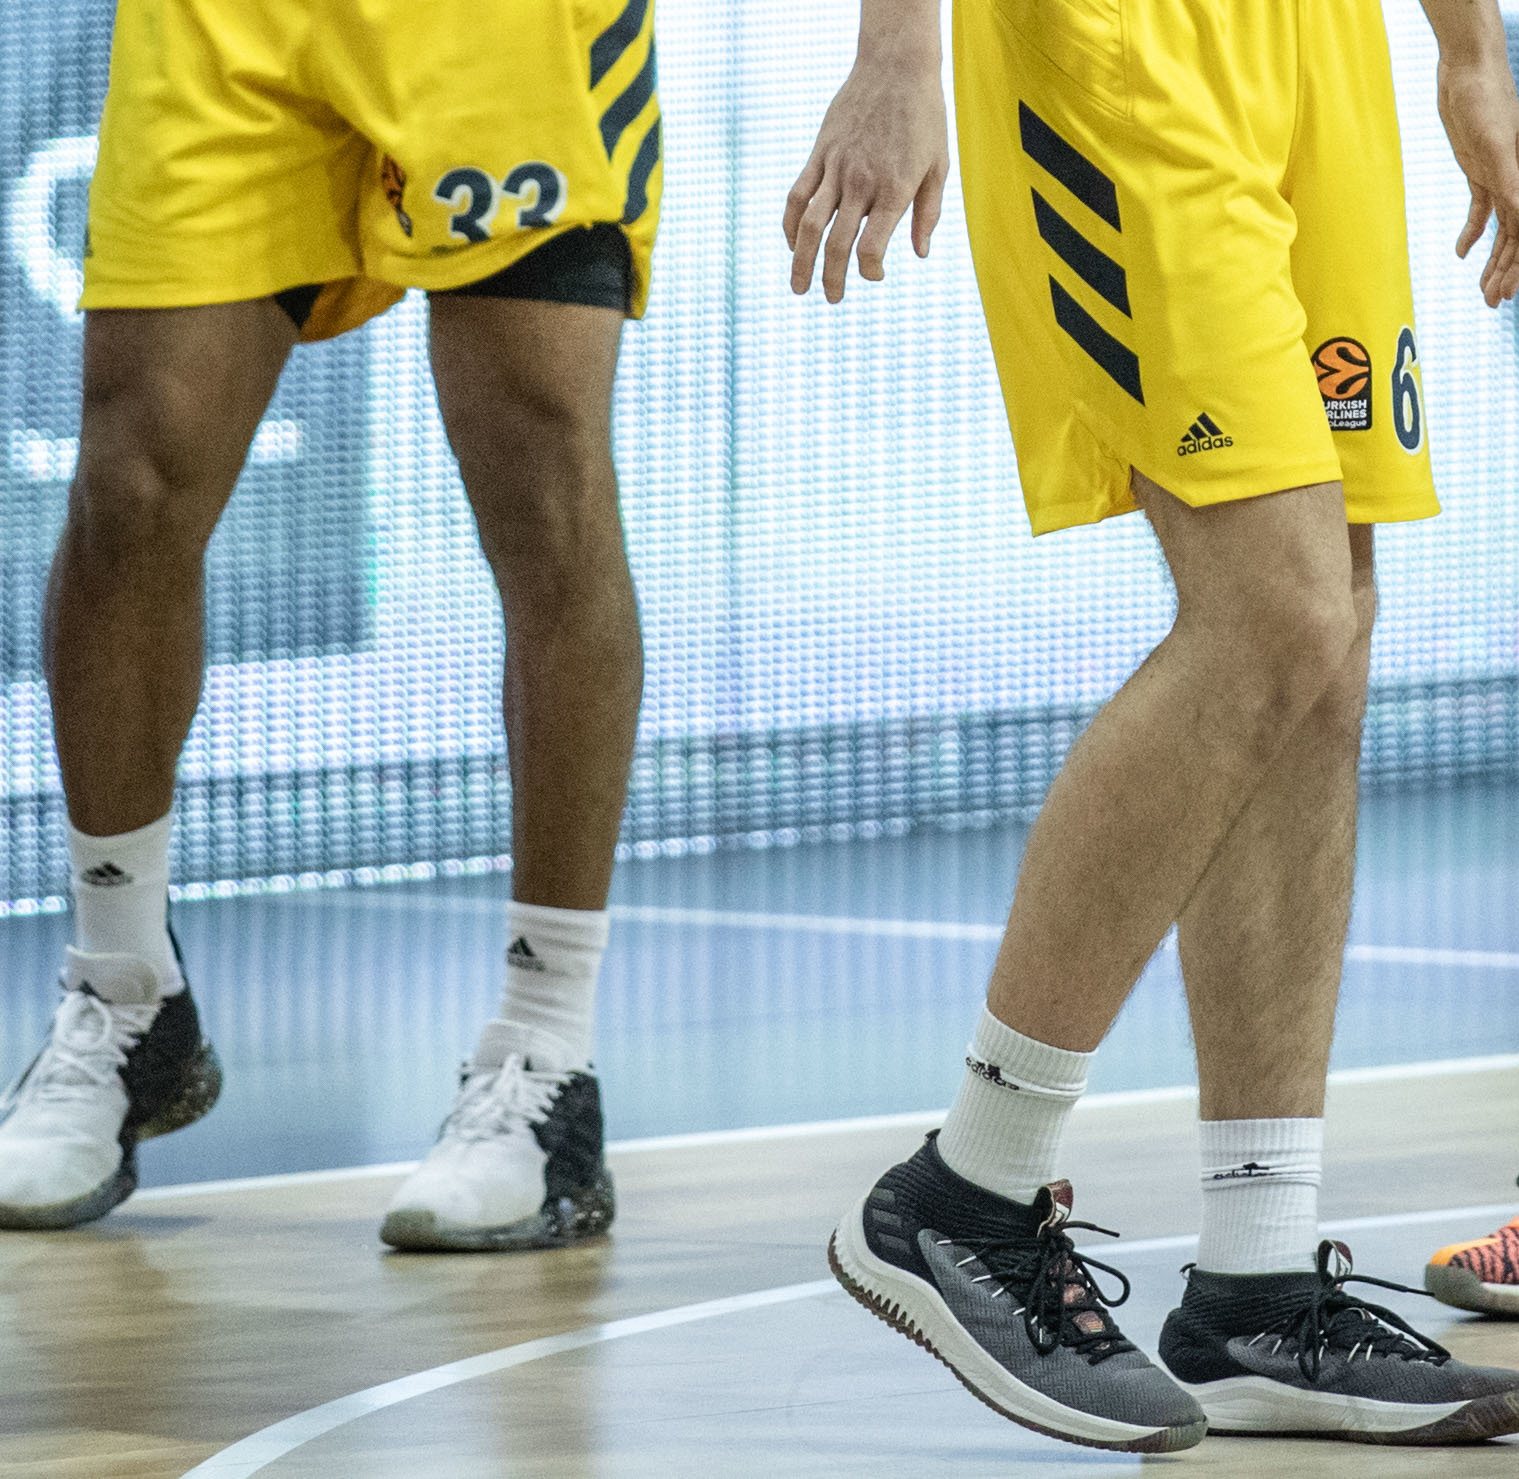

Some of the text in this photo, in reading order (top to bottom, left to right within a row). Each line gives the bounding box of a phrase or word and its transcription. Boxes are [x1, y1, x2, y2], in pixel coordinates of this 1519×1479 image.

[1391, 324, 1425, 456] 6
[1325, 399, 1368, 410] URKISH
[1327, 409, 1368, 420] RLINES
[1177, 434, 1234, 457] adidas
